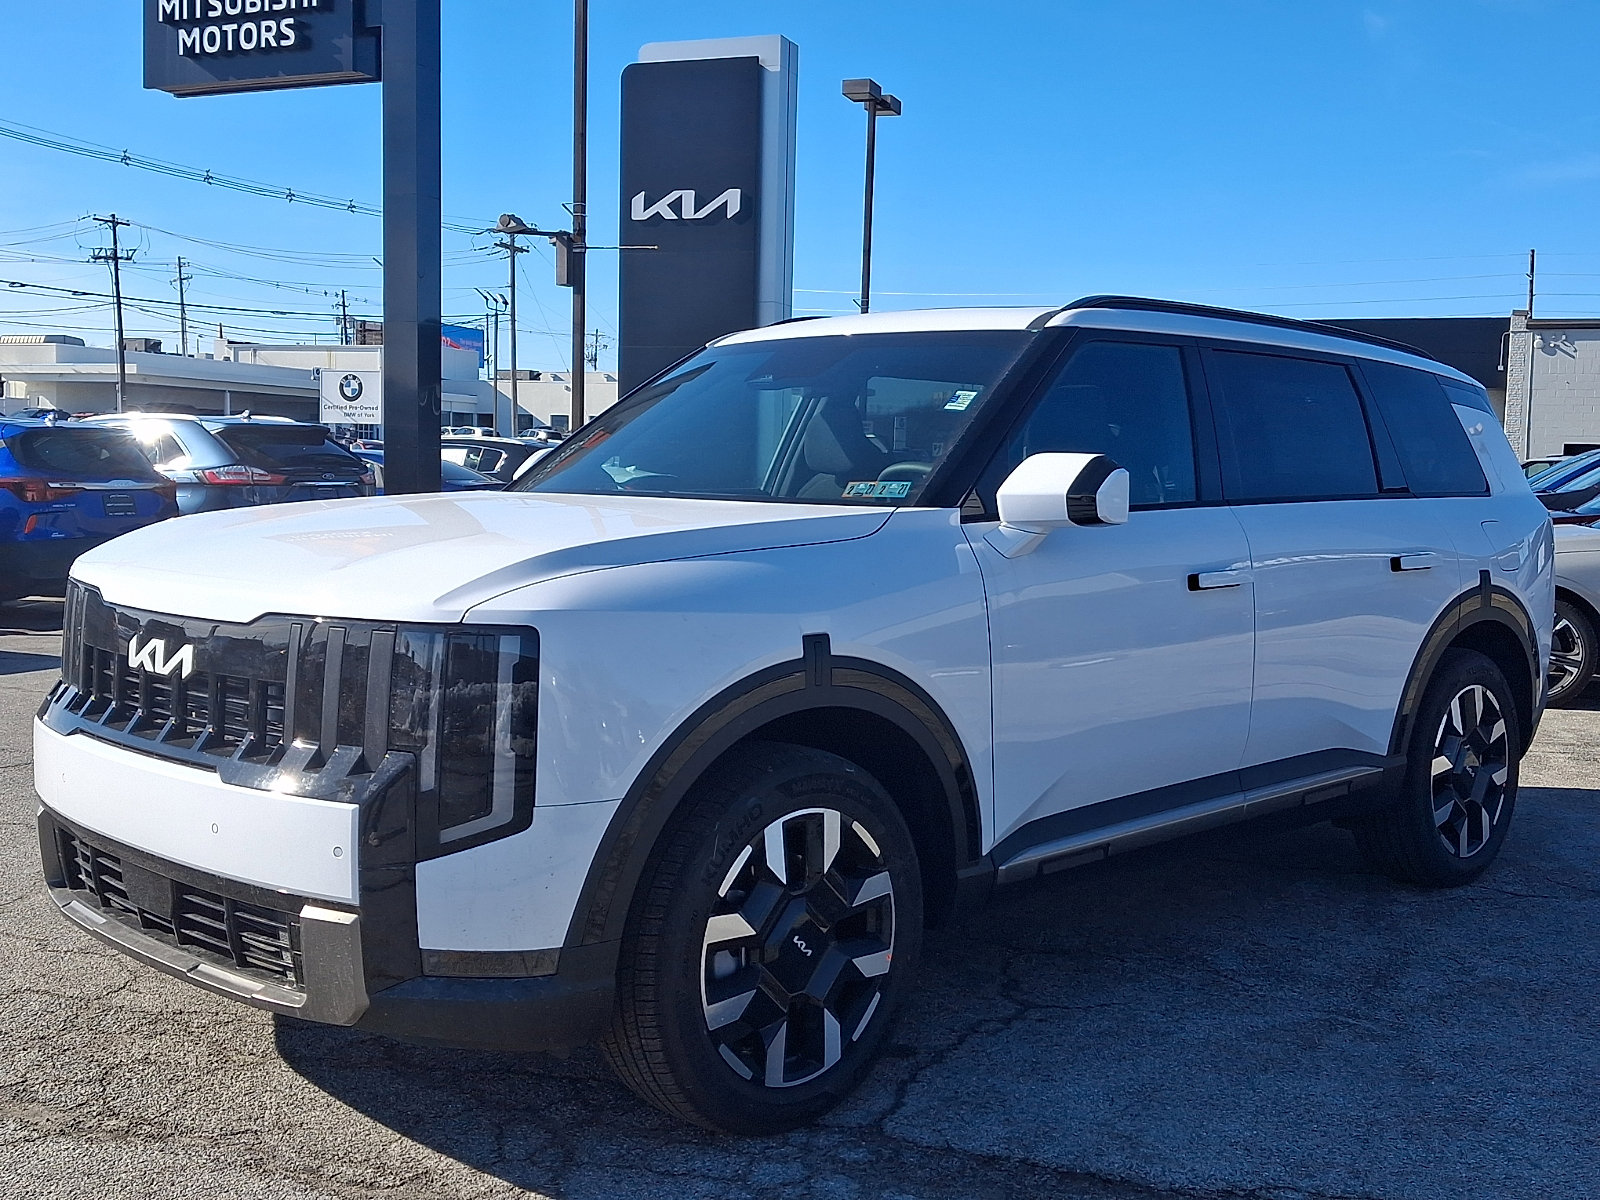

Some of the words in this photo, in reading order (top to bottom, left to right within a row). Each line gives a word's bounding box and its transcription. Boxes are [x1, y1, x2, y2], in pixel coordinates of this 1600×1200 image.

[178, 17, 296, 56] MOTORS
[631, 188, 742, 220] KIA
[128, 634, 194, 680] KIA
[793, 935, 812, 957] KIA
